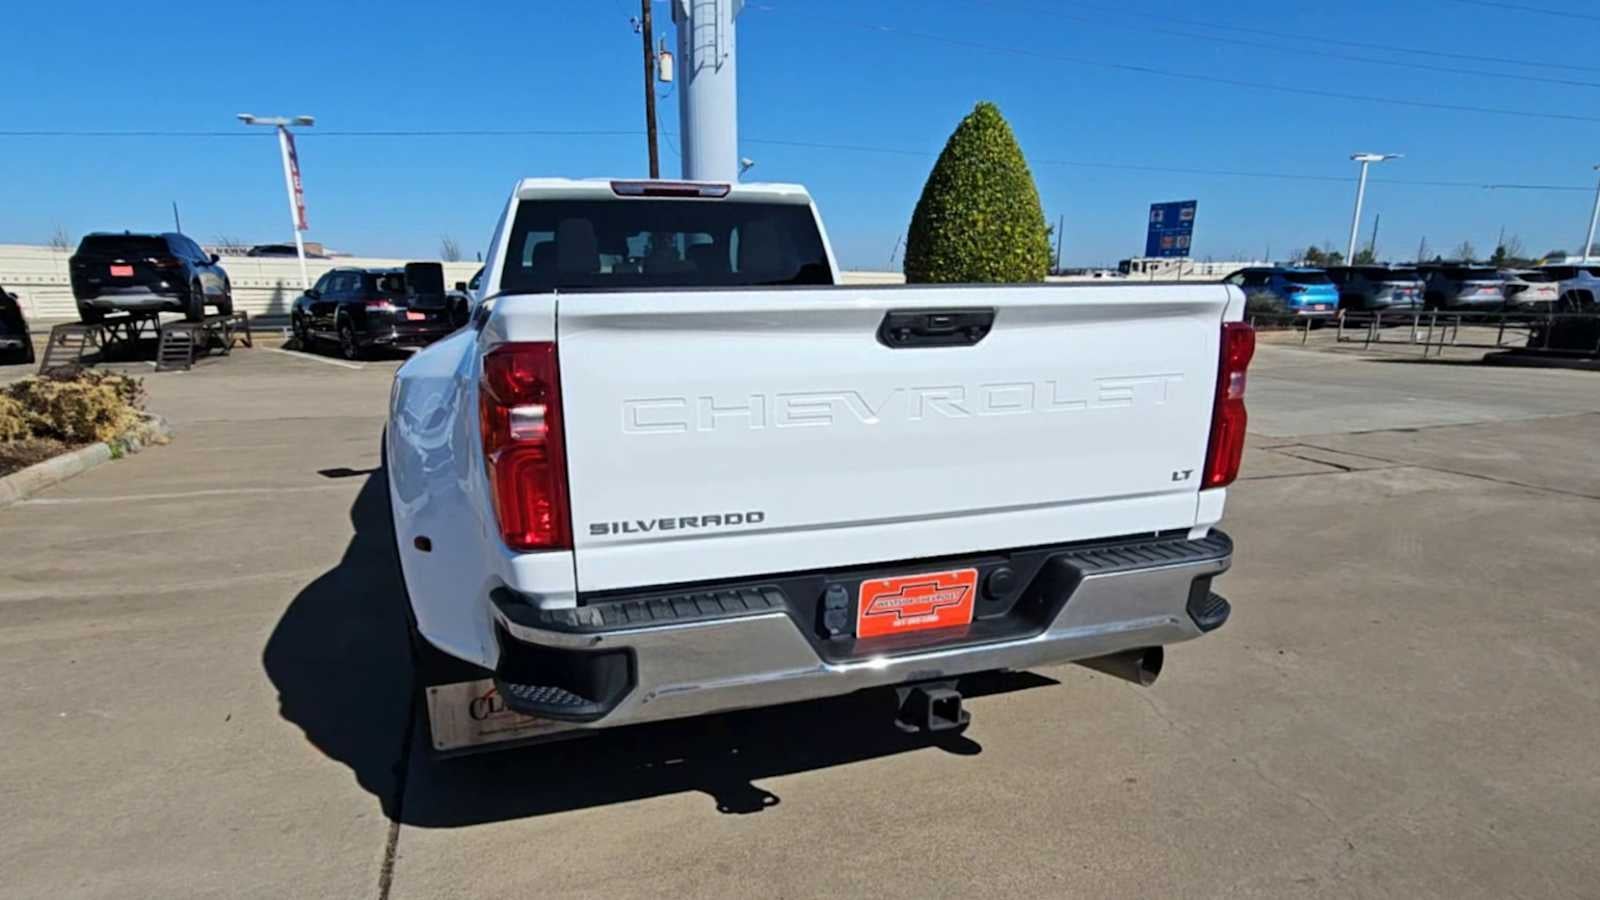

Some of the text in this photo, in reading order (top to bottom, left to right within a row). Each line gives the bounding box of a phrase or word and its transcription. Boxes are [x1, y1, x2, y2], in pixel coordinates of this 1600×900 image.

[622, 373, 1185, 434] CHEVROLET
[1171, 469, 1193, 482] LT
[588, 511, 766, 536] SILVERADO
